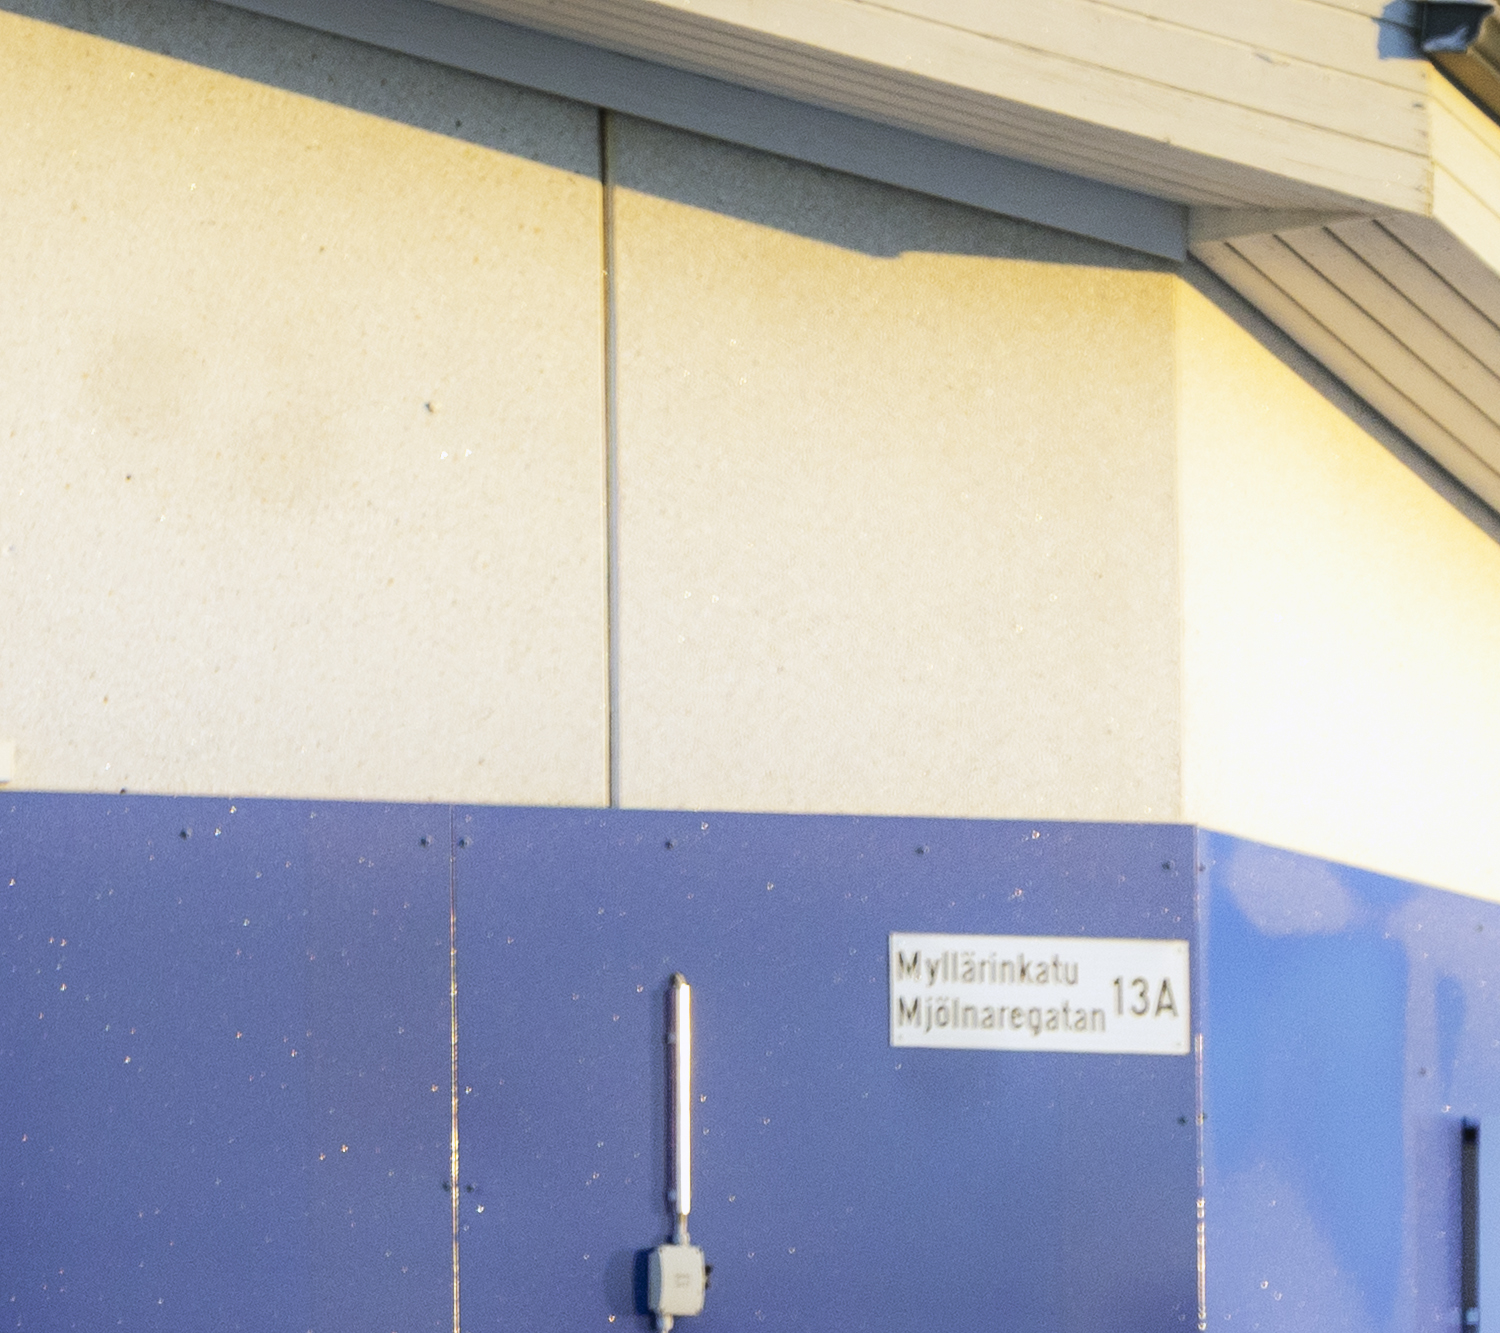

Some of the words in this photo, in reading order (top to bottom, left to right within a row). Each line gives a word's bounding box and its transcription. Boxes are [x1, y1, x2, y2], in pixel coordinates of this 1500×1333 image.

[895, 950, 1079, 986] Myllärinkatu
[896, 996, 1107, 1036] Mjölnaregatan
[1112, 975, 1179, 1018] 13A
